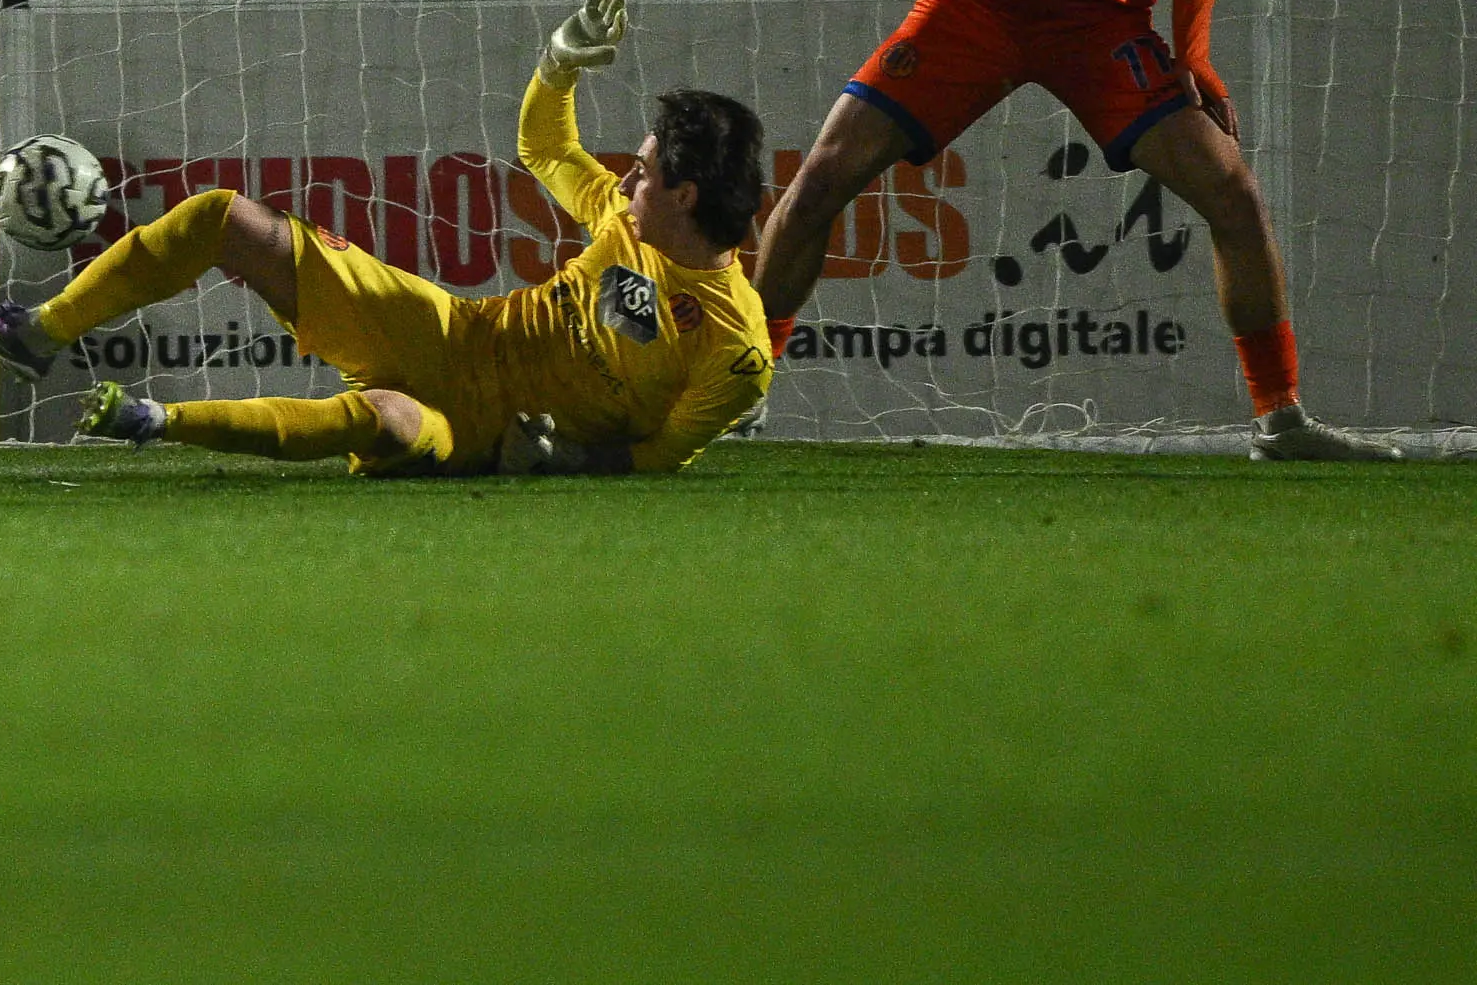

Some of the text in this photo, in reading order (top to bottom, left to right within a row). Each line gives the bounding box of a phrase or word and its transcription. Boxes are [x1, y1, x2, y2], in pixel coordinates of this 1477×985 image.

[617, 276, 653, 317] NSF
[69, 310, 1185, 368] soluzion ampa digitale
